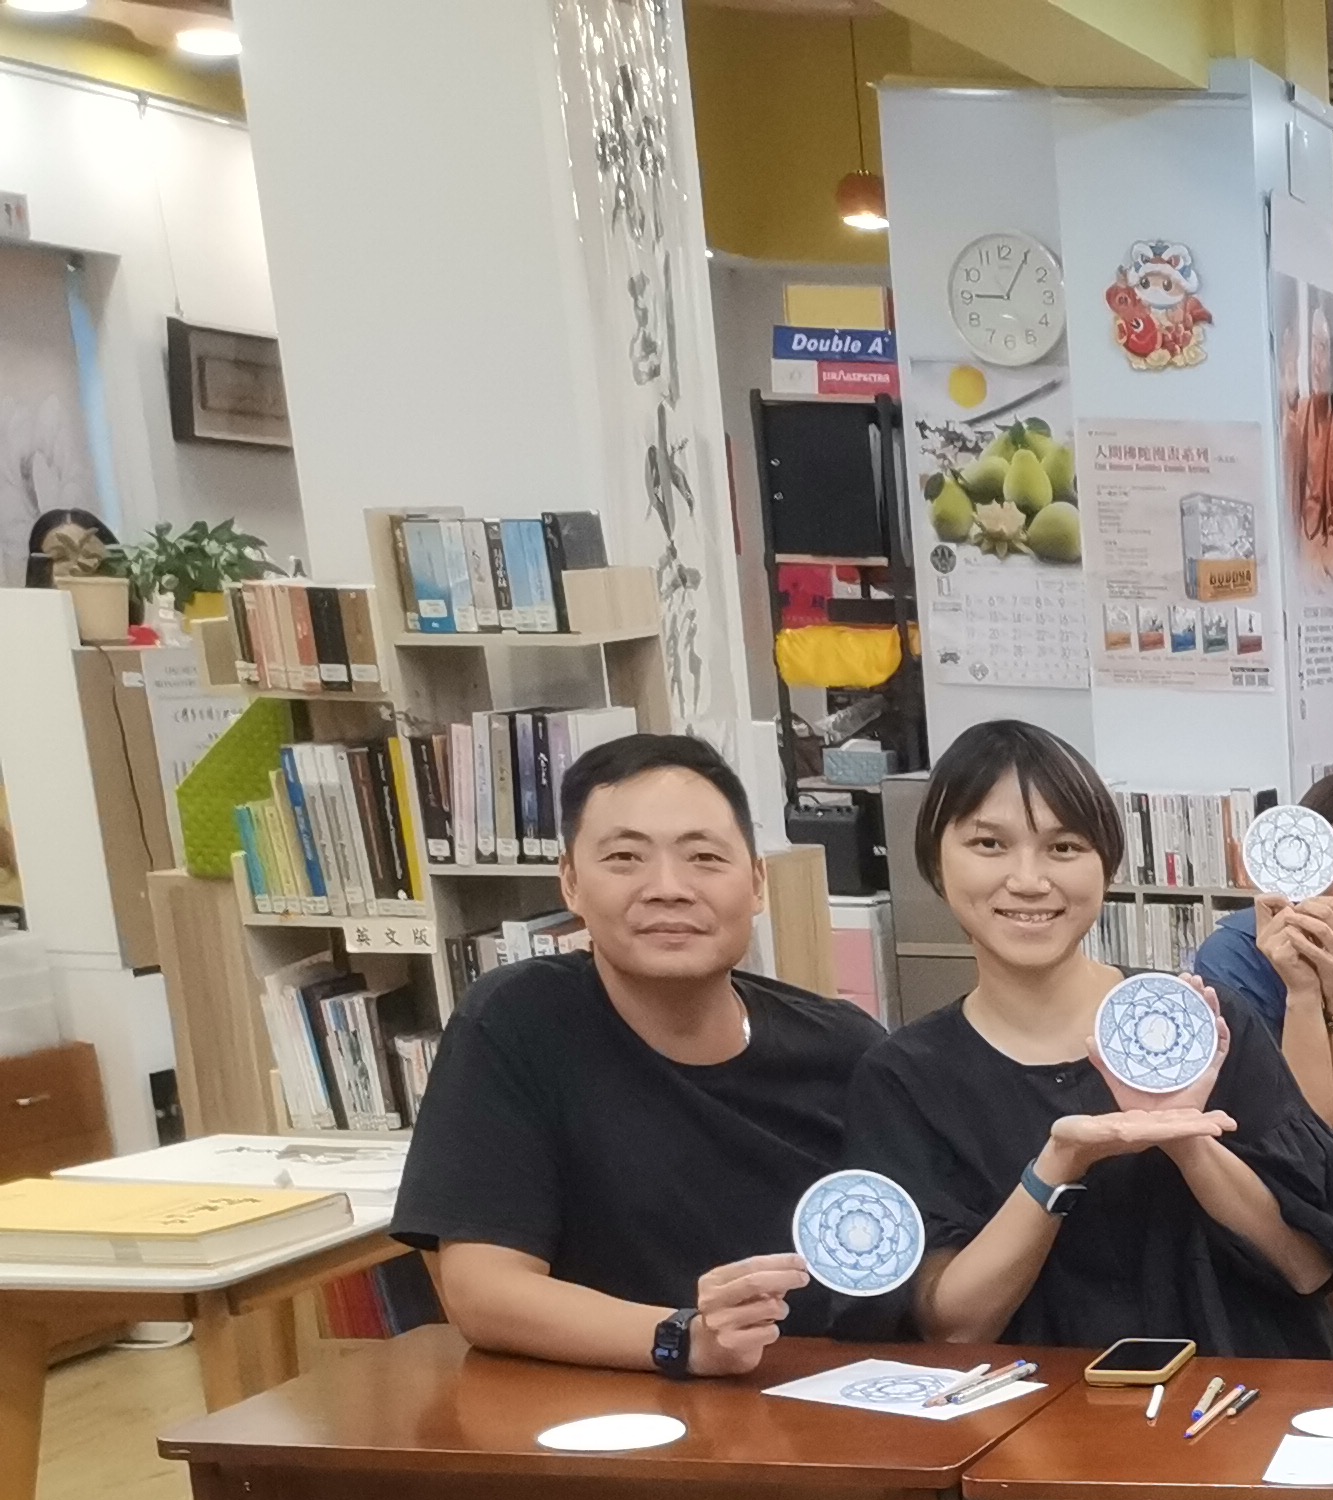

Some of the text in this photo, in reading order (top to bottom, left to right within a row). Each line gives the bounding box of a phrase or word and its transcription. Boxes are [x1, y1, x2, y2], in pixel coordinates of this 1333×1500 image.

[979, 249, 990, 265] 11
[997, 244, 1011, 261] 12
[964, 268, 981, 283] 10
[1036, 267, 1048, 284] 2
[960, 290, 974, 306] 9
[1042, 290, 1054, 305] 3
[968, 313, 981, 327] 8
[1038, 314, 1050, 327] 4
[791, 333, 883, 355] Double A
[985, 329, 997, 344] 7
[1004, 335, 1016, 350] 6
[356, 927, 431, 946] 英文版
